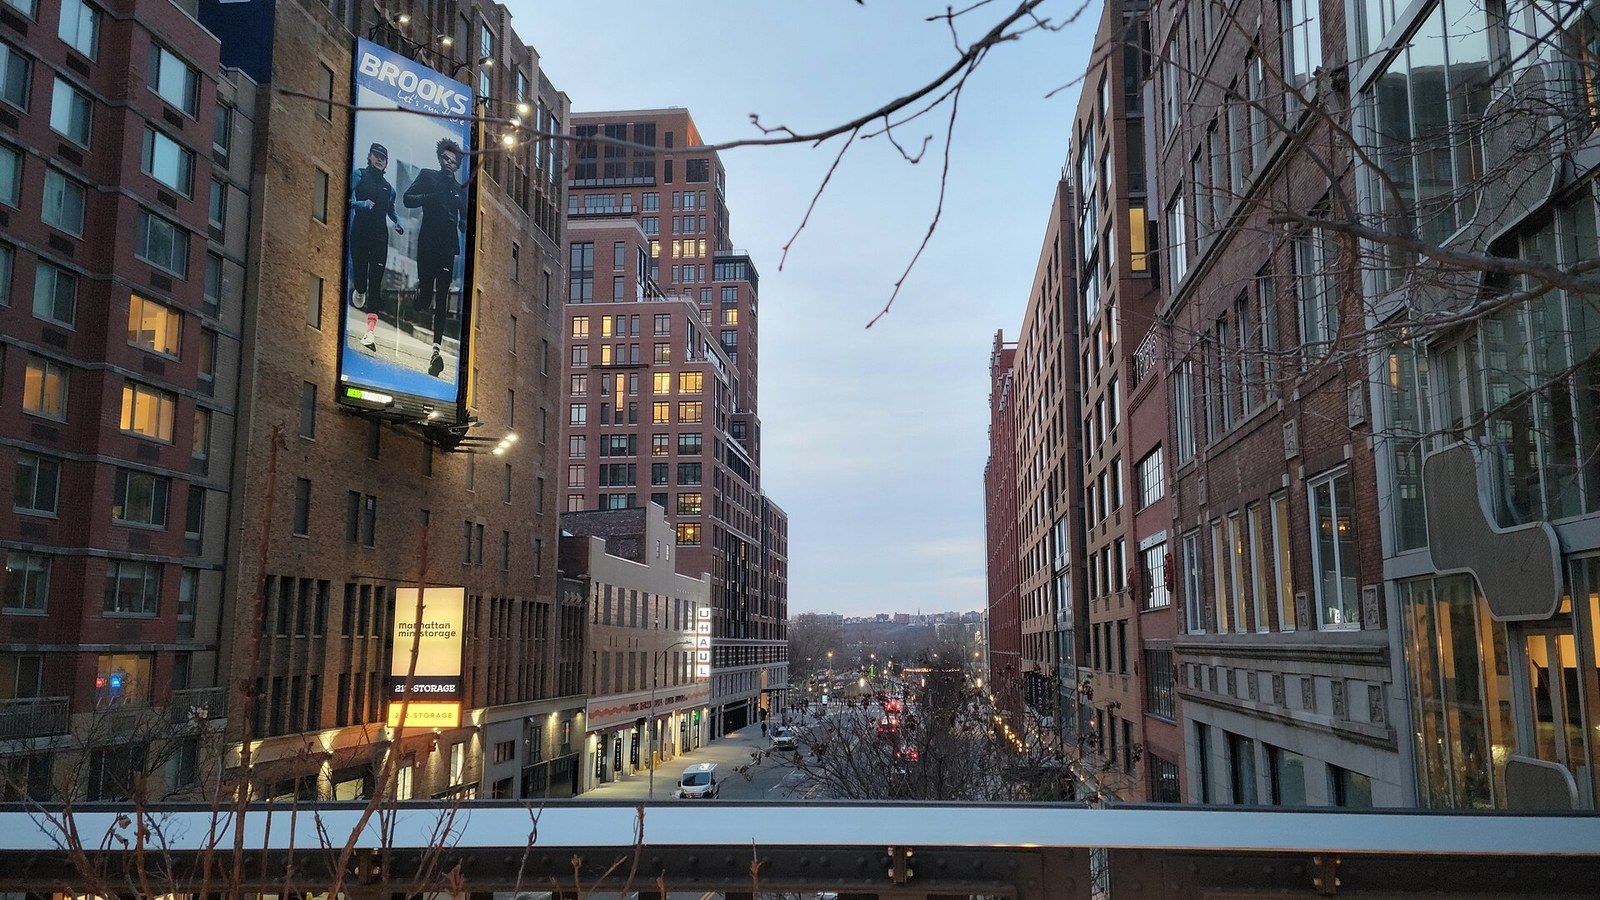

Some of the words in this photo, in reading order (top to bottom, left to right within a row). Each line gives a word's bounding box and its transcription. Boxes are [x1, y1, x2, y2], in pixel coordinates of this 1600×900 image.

[358, 52, 469, 115] BROOKS
[397, 89, 420, 107] Let's
[423, 104, 439, 114] run
[398, 629, 417, 637] min
[394, 684, 456, 693] 21-STORAGE
